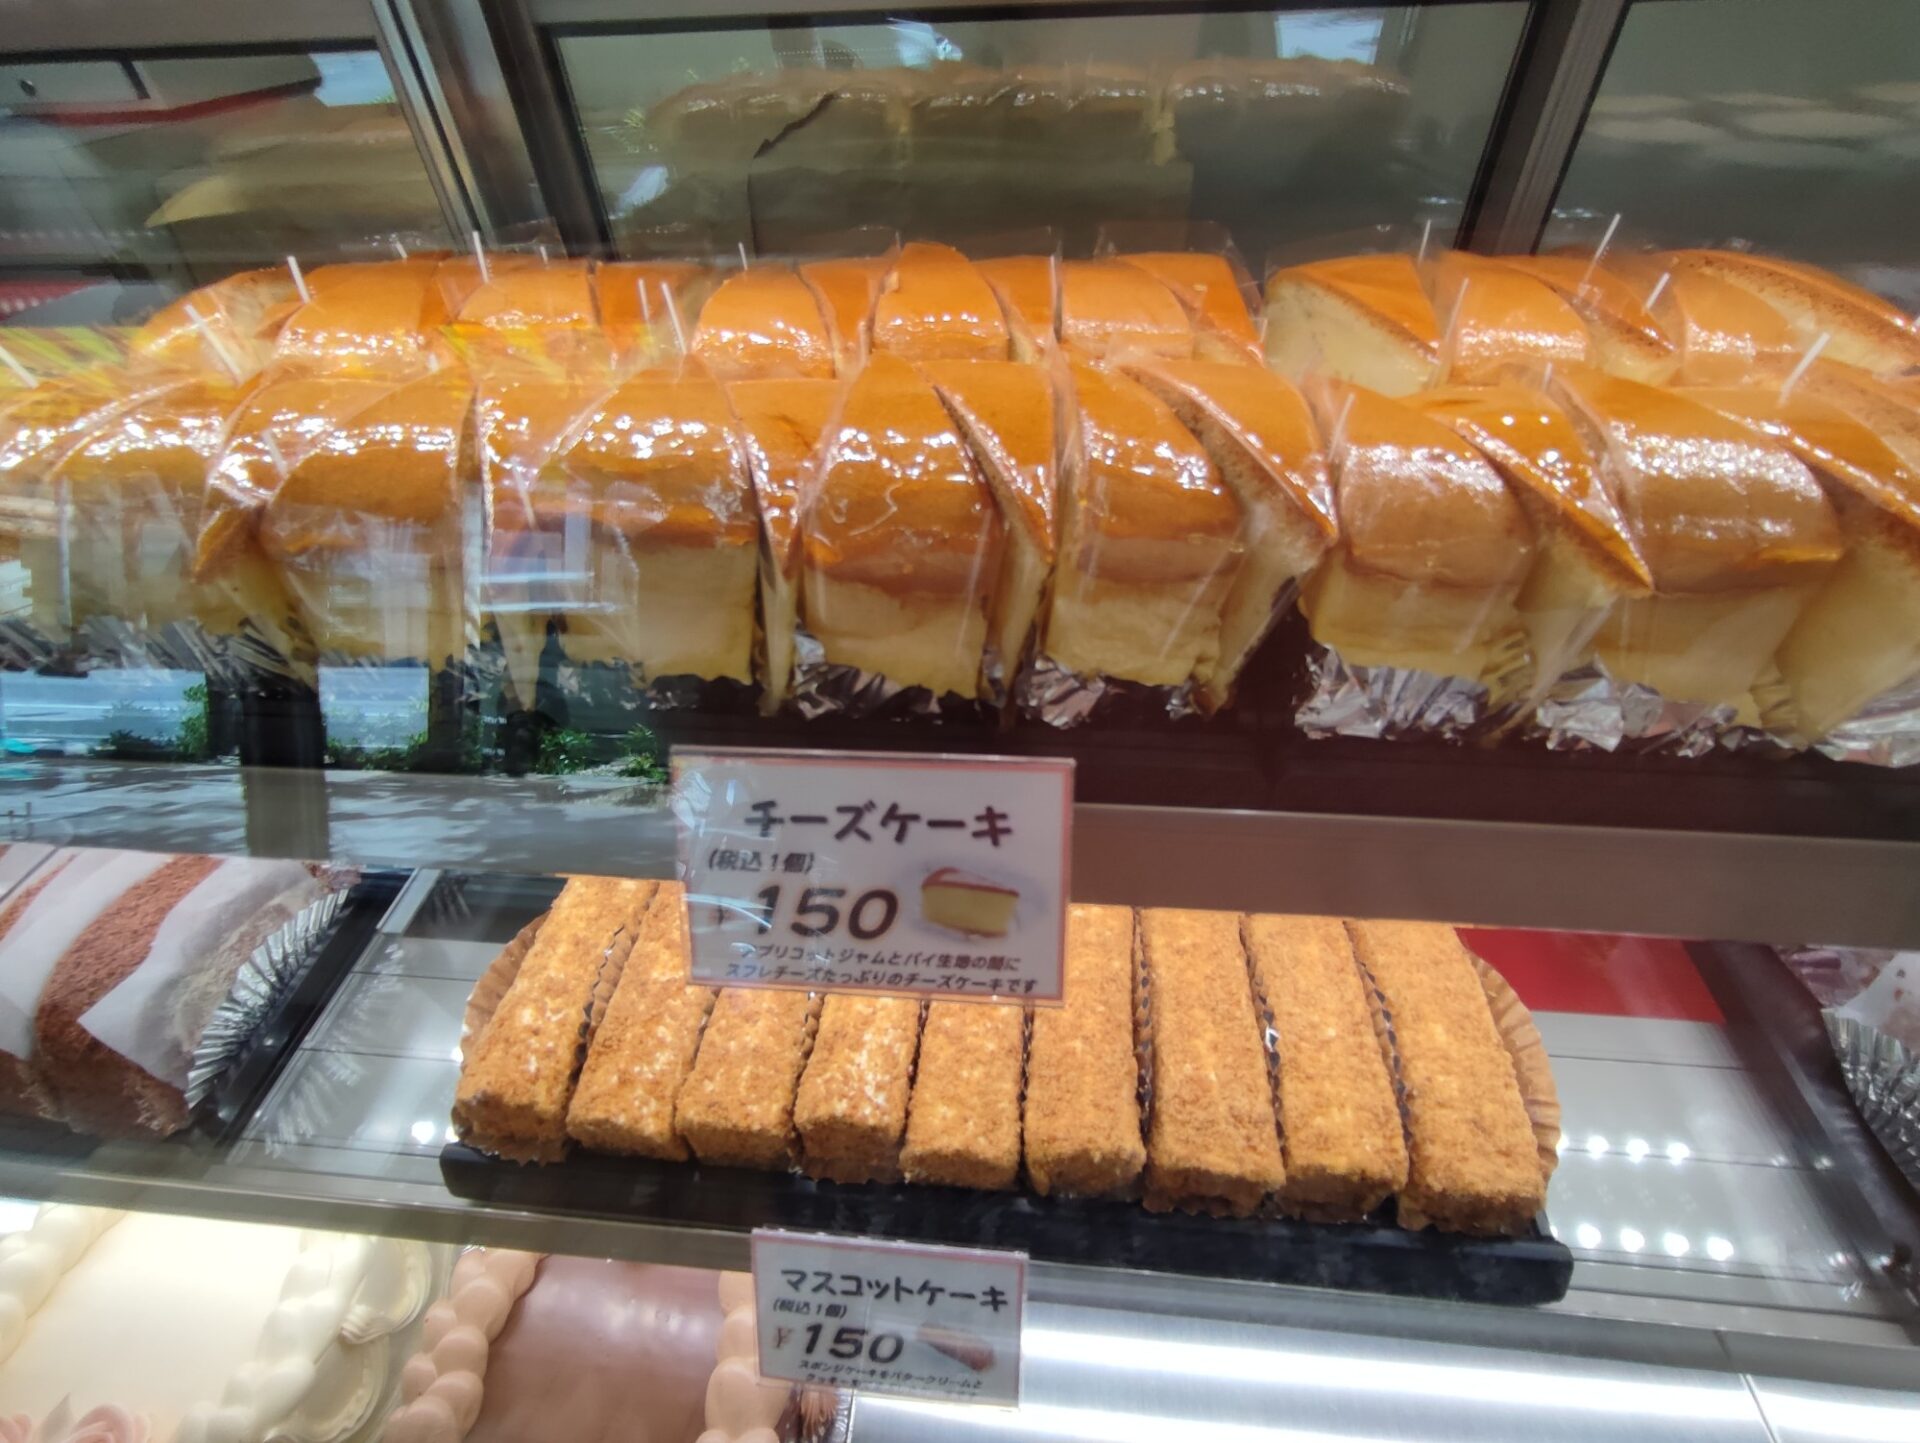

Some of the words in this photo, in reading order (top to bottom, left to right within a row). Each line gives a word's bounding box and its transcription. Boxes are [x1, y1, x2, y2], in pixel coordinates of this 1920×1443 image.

[744, 799, 1014, 847] チーズケーキ
[780, 1268, 1009, 1314] マスコットケーキ
[775, 1323, 905, 1364] ¥150
